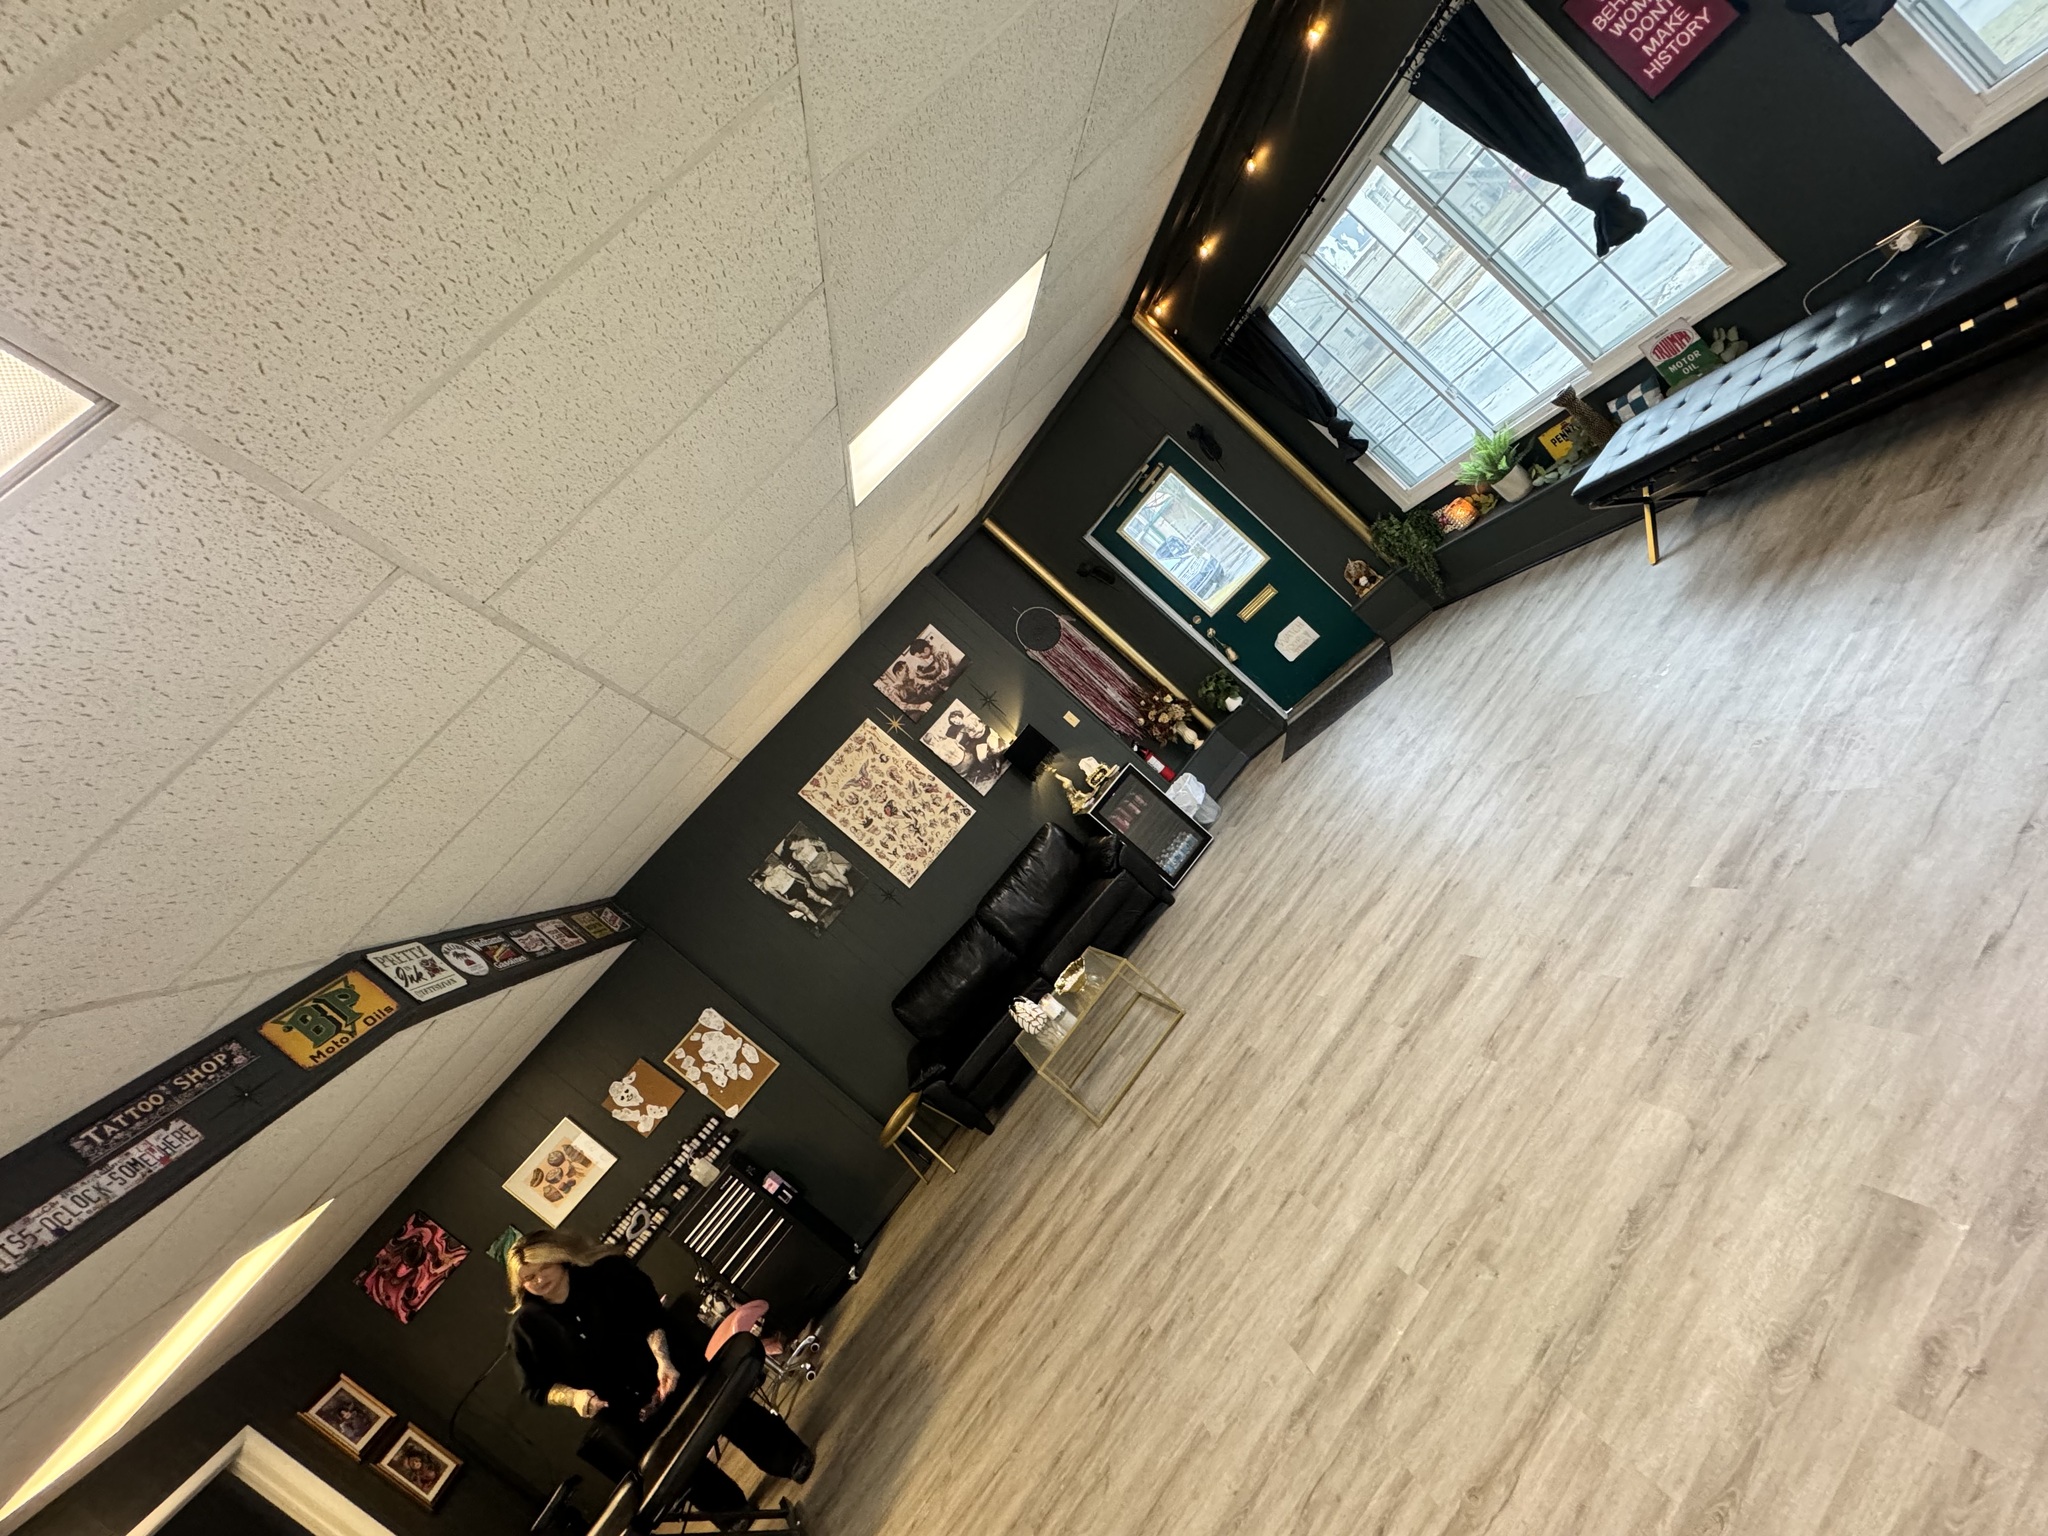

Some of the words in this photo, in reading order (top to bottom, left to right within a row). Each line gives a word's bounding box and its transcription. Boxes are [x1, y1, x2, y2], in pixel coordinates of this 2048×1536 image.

[1592, 0, 1626, 31] BEH
[1641, 5, 1691, 57] MAKE
[1643, 6, 1711, 79] HISTORY
[1652, 331, 1691, 360] TRIUMPH
[1668, 350, 1702, 373] MOTOR
[1682, 363, 1700, 374] OIL
[373, 945, 428, 968] PRETTY
[395, 965, 428, 988] Ink
[283, 985, 364, 1049] BP
[309, 1031, 358, 1064] Motor
[363, 1005, 394, 1027] Oils
[173, 1053, 228, 1091] SHOP
